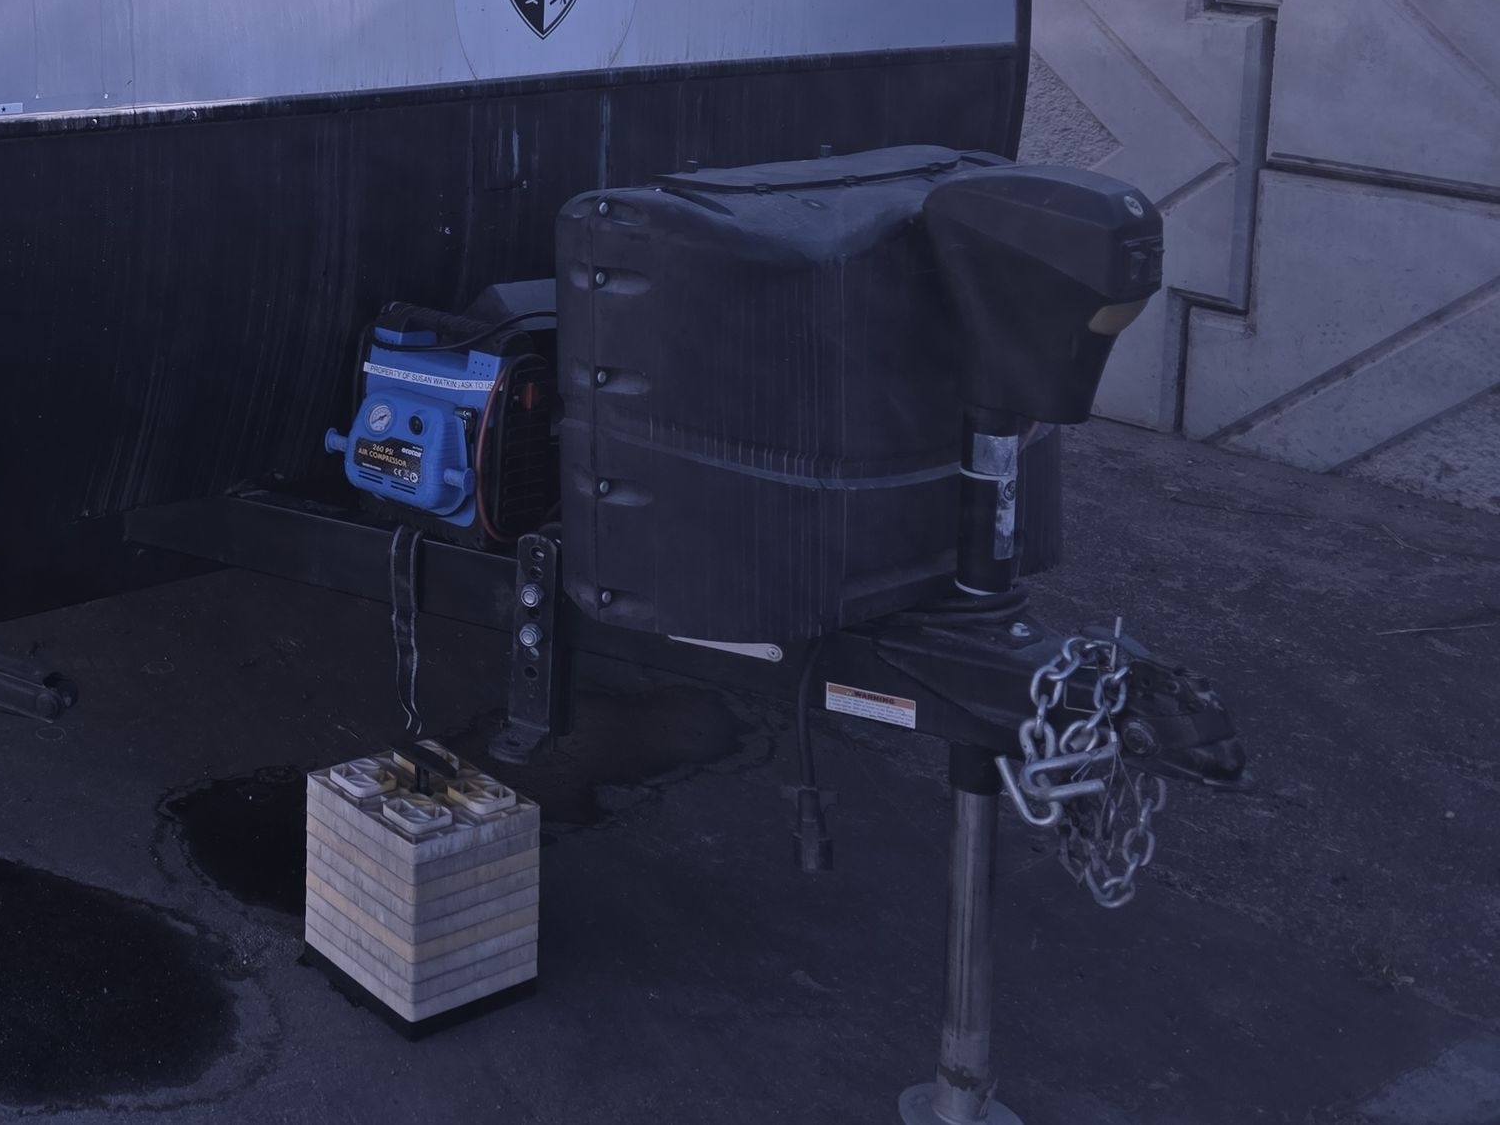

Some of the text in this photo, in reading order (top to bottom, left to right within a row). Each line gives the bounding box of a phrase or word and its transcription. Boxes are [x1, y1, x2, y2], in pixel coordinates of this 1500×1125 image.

[370, 365, 400, 377] PROPERTY
[402, 371, 410, 379] OF
[411, 373, 431, 384] SUSAN
[372, 443, 385, 453] 260
[358, 447, 369, 456] AIR
[369, 450, 407, 467] COMPRESSOR
[855, 690, 895, 705] WARNING
